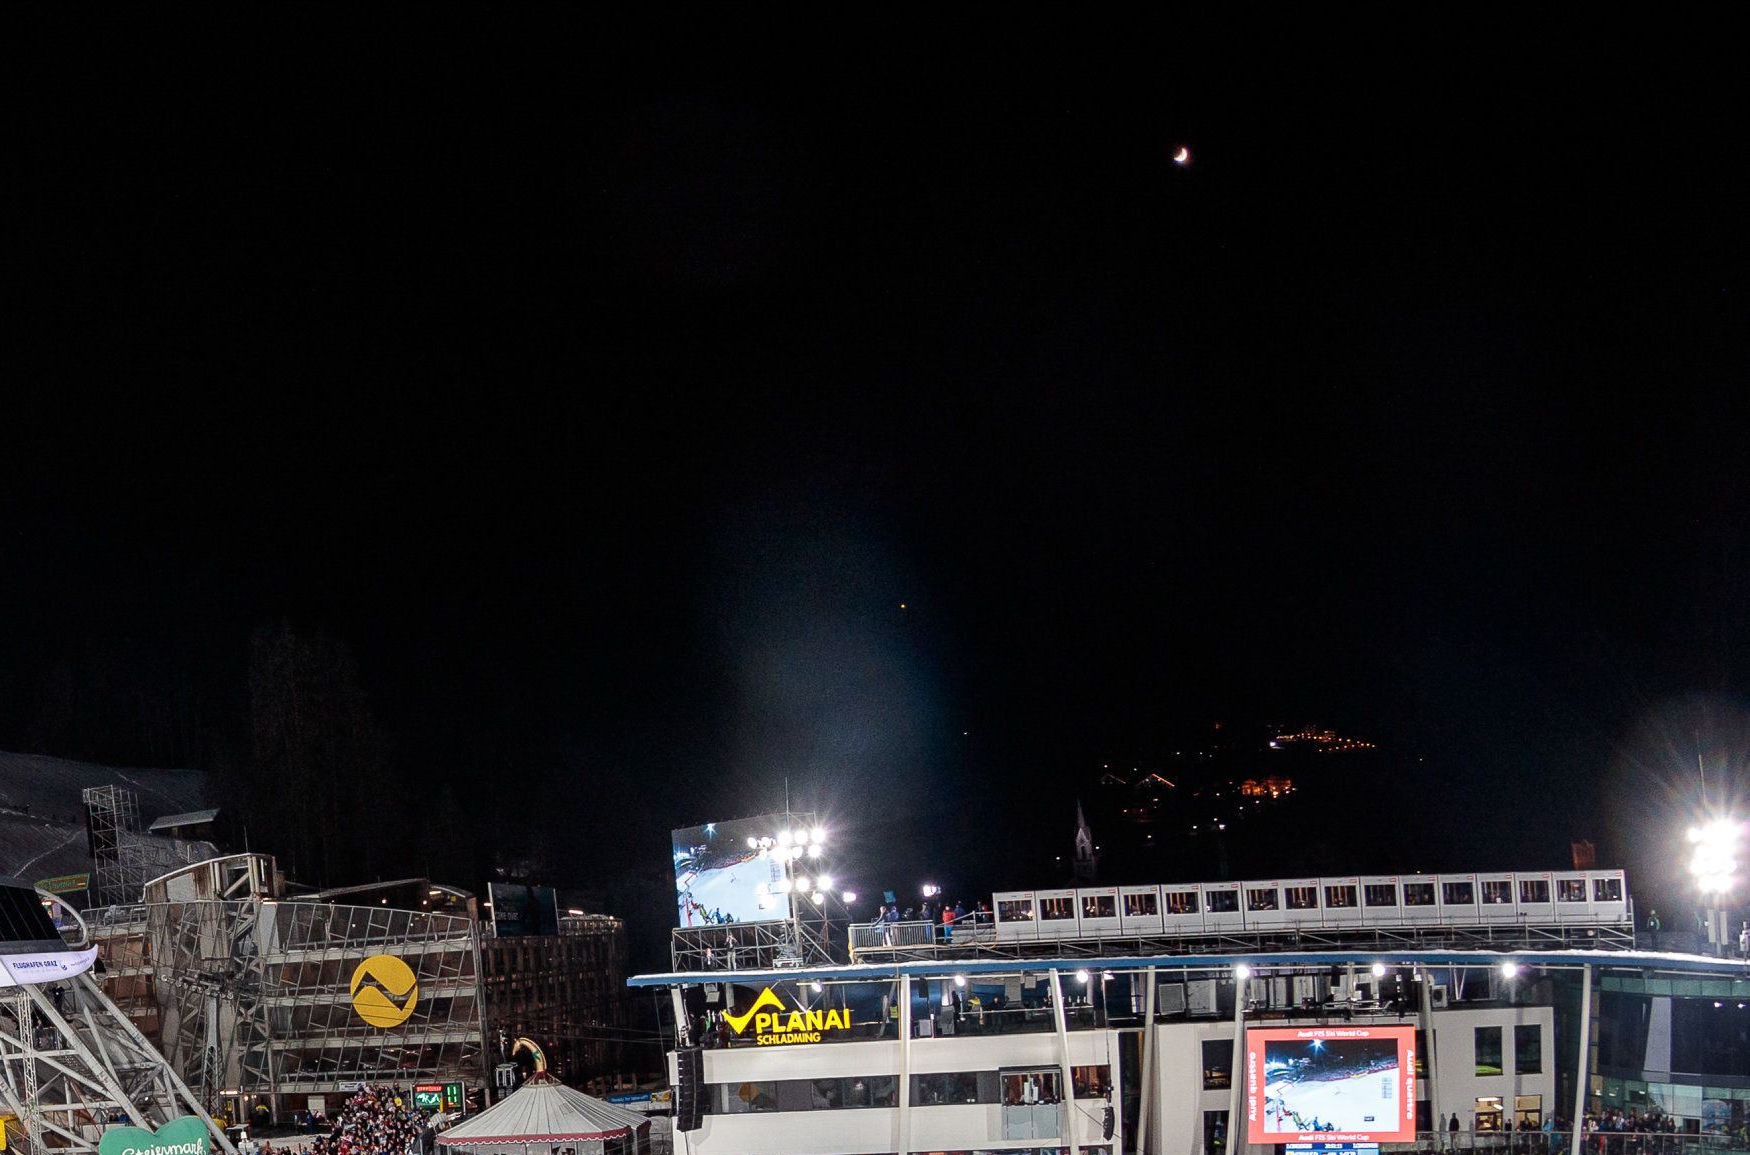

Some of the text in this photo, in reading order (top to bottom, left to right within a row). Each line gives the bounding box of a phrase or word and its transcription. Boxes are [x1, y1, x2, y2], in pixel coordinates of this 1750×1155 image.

[13, 960, 58, 969] FLUGHAFEN GRAZ
[755, 1008, 850, 1034] PLANAI
[756, 1032, 821, 1046] SCHLADMING
[1297, 1030, 1313, 1038] Audi
[1356, 1029, 1369, 1038] Cup
[1405, 1077, 1414, 1120] quattro
[1337, 1133, 1356, 1141] World
[1357, 1134, 1369, 1142] Cup
